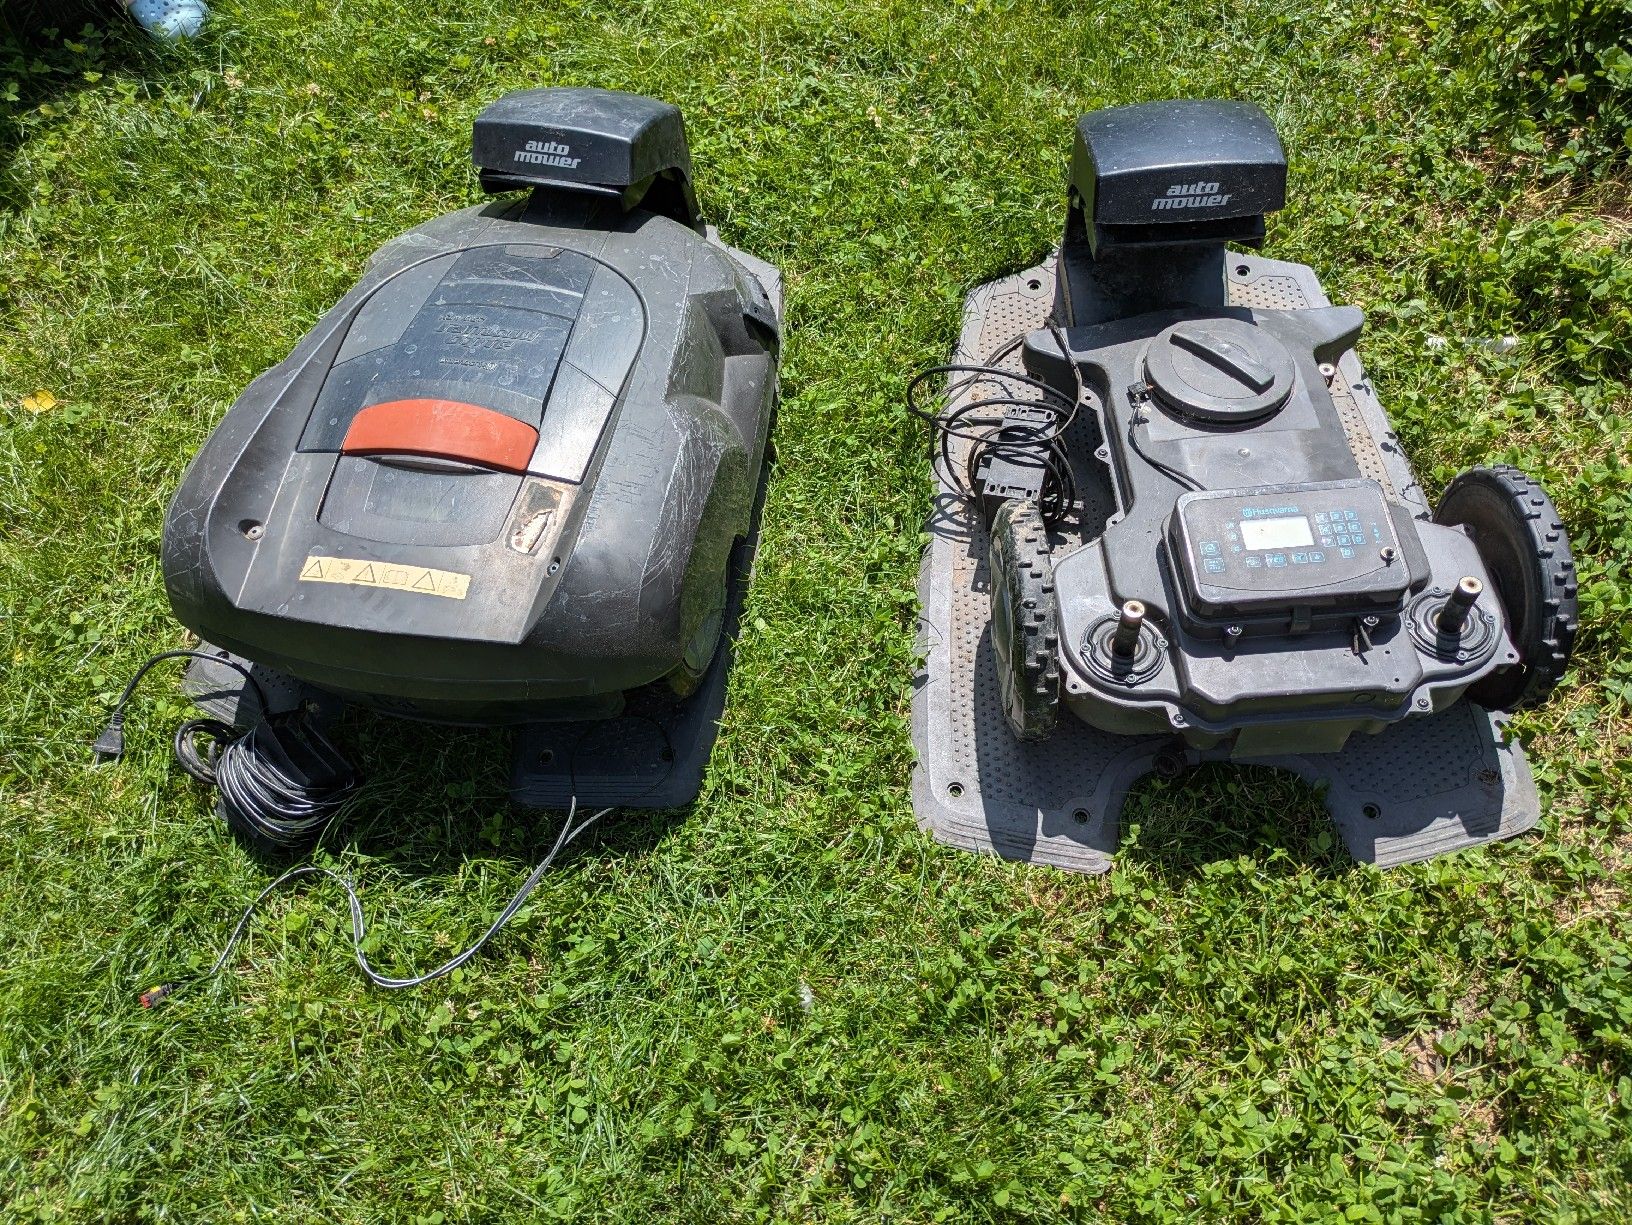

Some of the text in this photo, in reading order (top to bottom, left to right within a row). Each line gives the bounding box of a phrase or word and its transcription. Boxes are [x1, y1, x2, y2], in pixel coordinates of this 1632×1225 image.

[526, 140, 570, 156] auto
[514, 150, 582, 169] mower
[1166, 181, 1220, 196] auto
[1151, 194, 1232, 210] mower
[1253, 506, 1298, 515] Husqvarna
